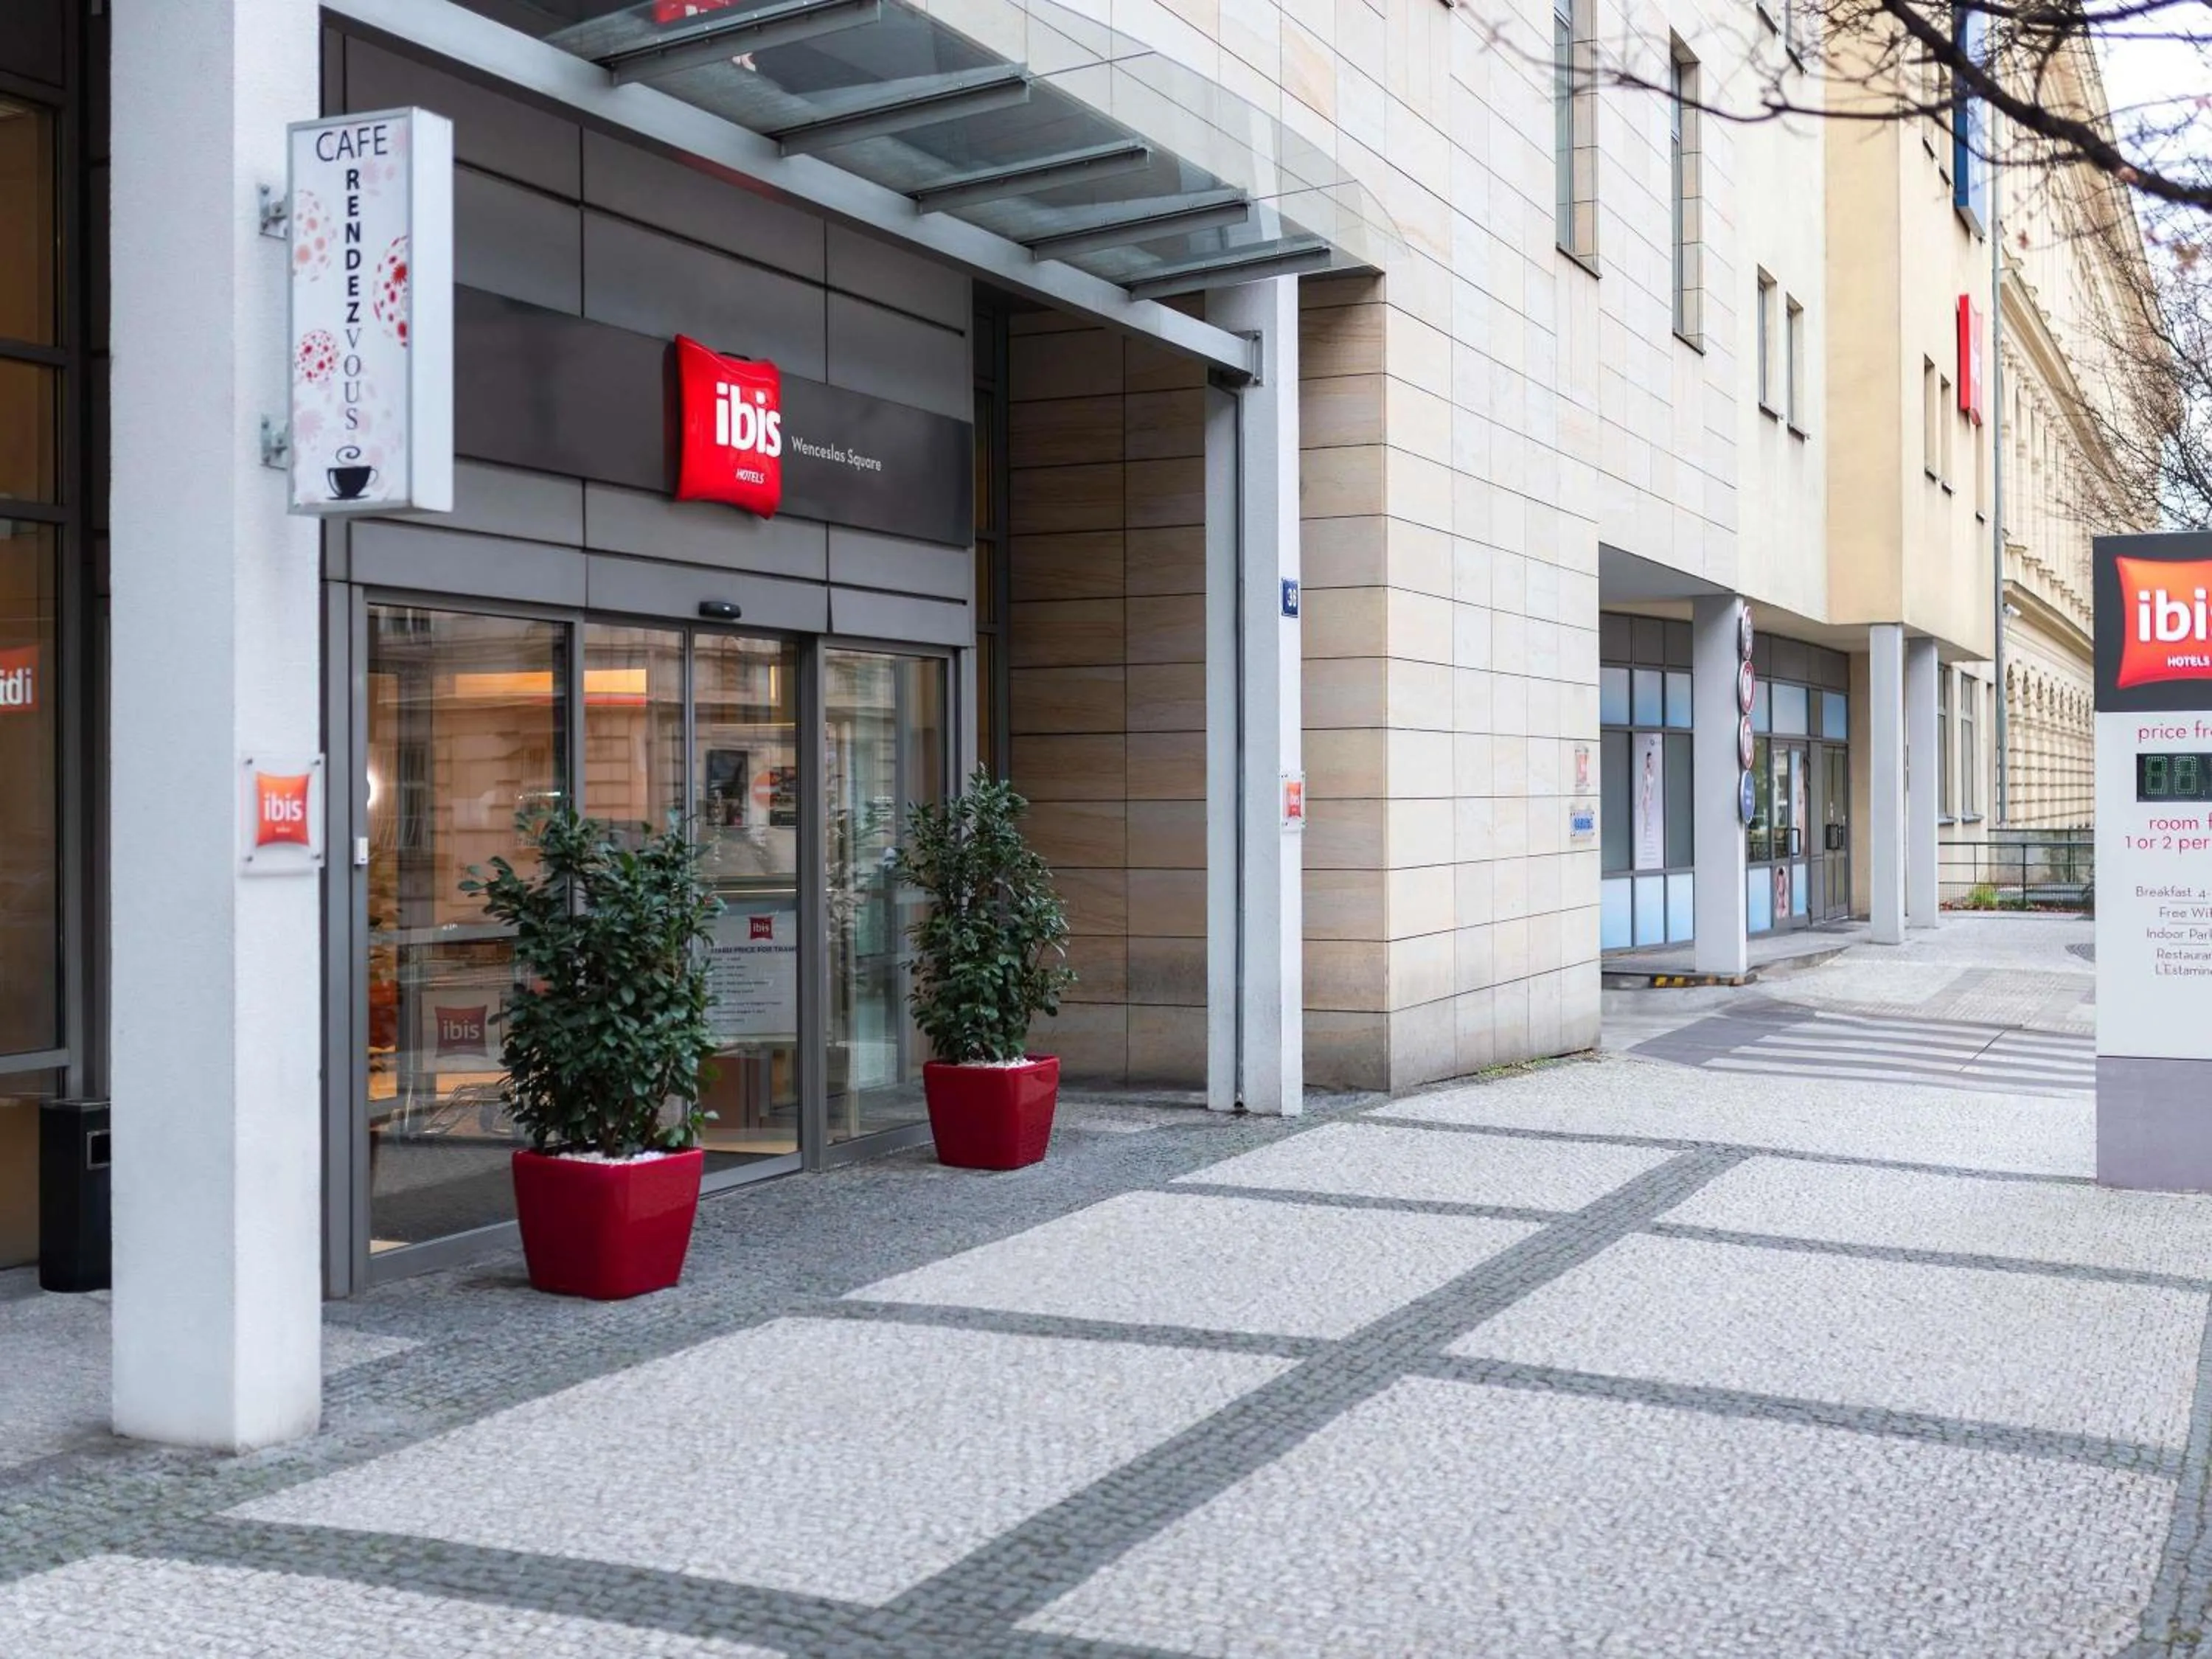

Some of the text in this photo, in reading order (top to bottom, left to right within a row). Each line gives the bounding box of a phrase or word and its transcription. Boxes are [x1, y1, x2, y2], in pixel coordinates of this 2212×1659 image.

[316, 124, 389, 162] CAFE
[716, 381, 782, 458] ibis
[791, 436, 883, 472] Wenceslas Square
[735, 468, 765, 484] HOTELS
[2138, 587, 2212, 642] ibi
[2167, 655, 2211, 667] HOTELS
[2138, 720, 2212, 744] price fr
[264, 792, 304, 822] ibis
[2149, 818, 2199, 830] room
[2125, 835, 2132, 849] 1
[2138, 838, 2157, 849] or
[2162, 835, 2172, 849] 2
[2135, 885, 2191, 897] Breakfast
[2158, 906, 2187, 918] Free
[752, 922, 770, 933] ibis
[2146, 927, 2185, 939] Indoor
[443, 1019, 480, 1040] ibis
